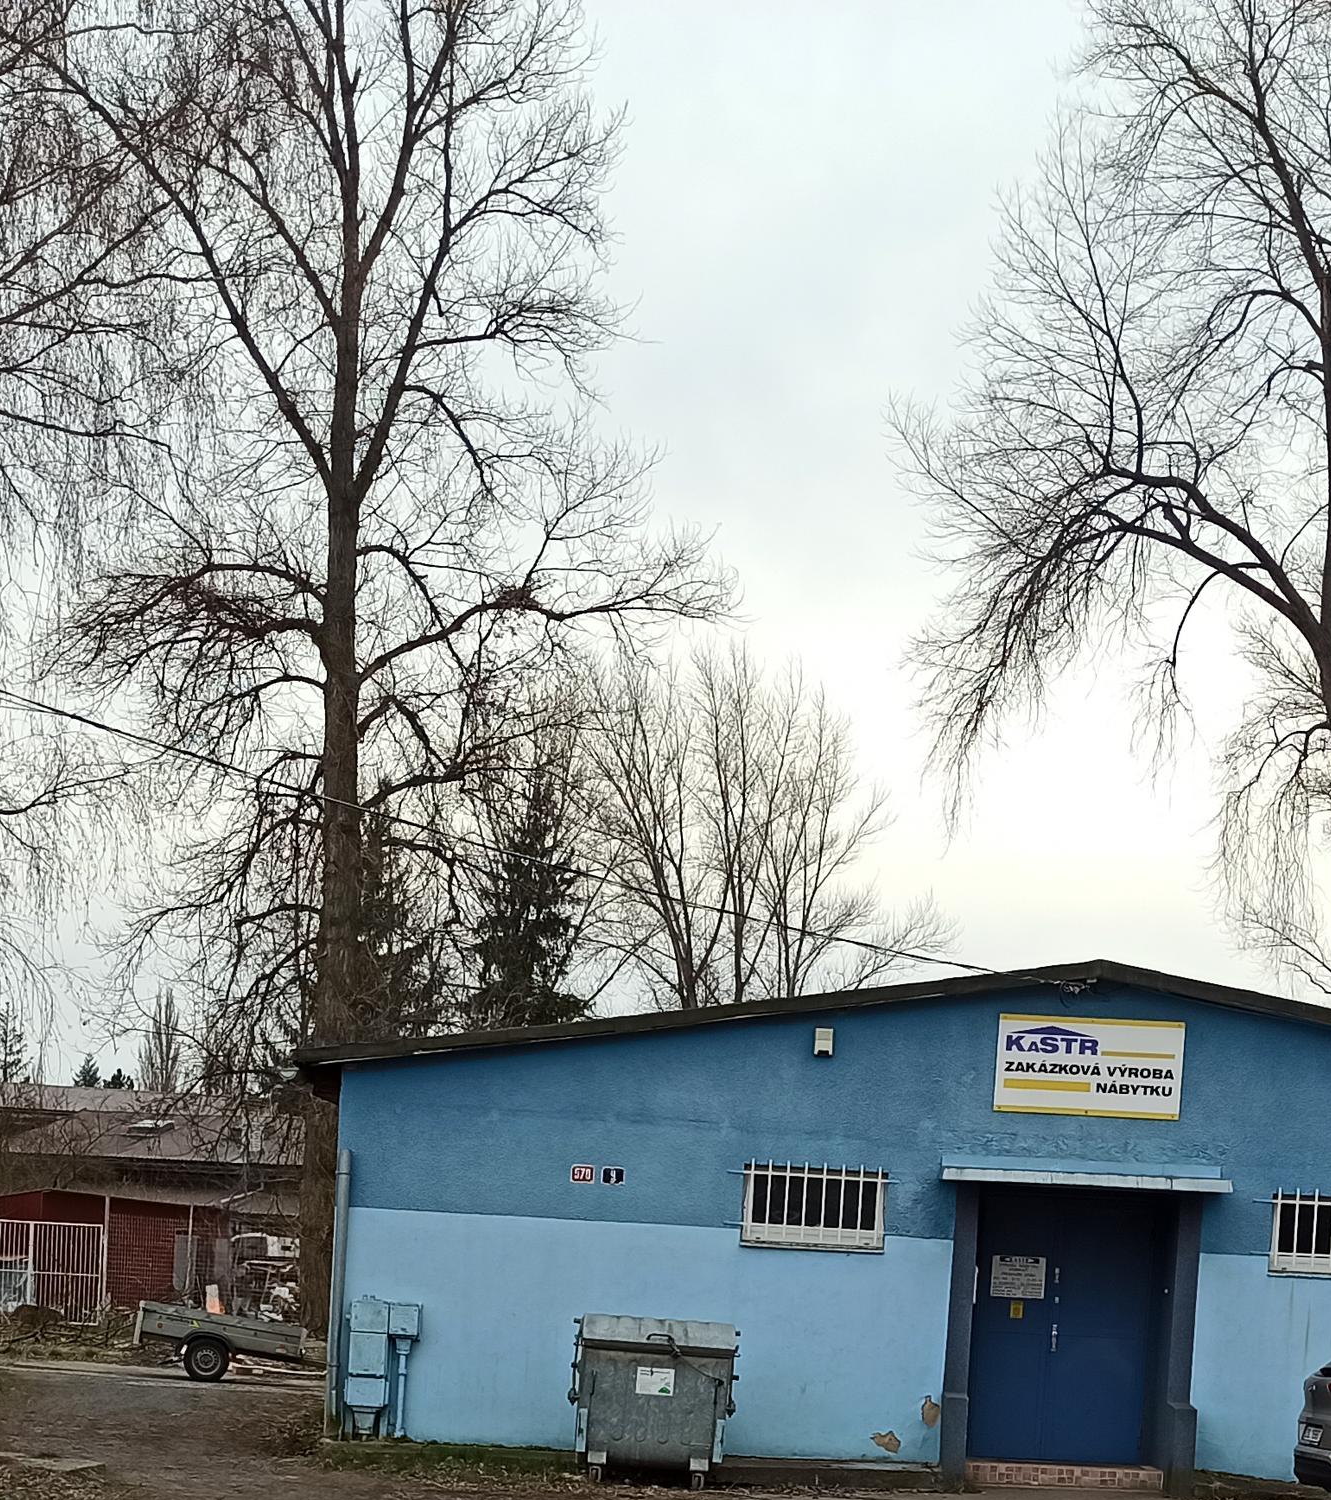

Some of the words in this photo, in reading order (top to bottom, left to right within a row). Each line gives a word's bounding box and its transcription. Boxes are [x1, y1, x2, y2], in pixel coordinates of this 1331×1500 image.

[1003, 1060, 1101, 1077] ZAKÁZKOVÁ
[1106, 1063, 1175, 1081] VÝROBA
[1095, 1080, 1173, 1098] NÁBYTKU
